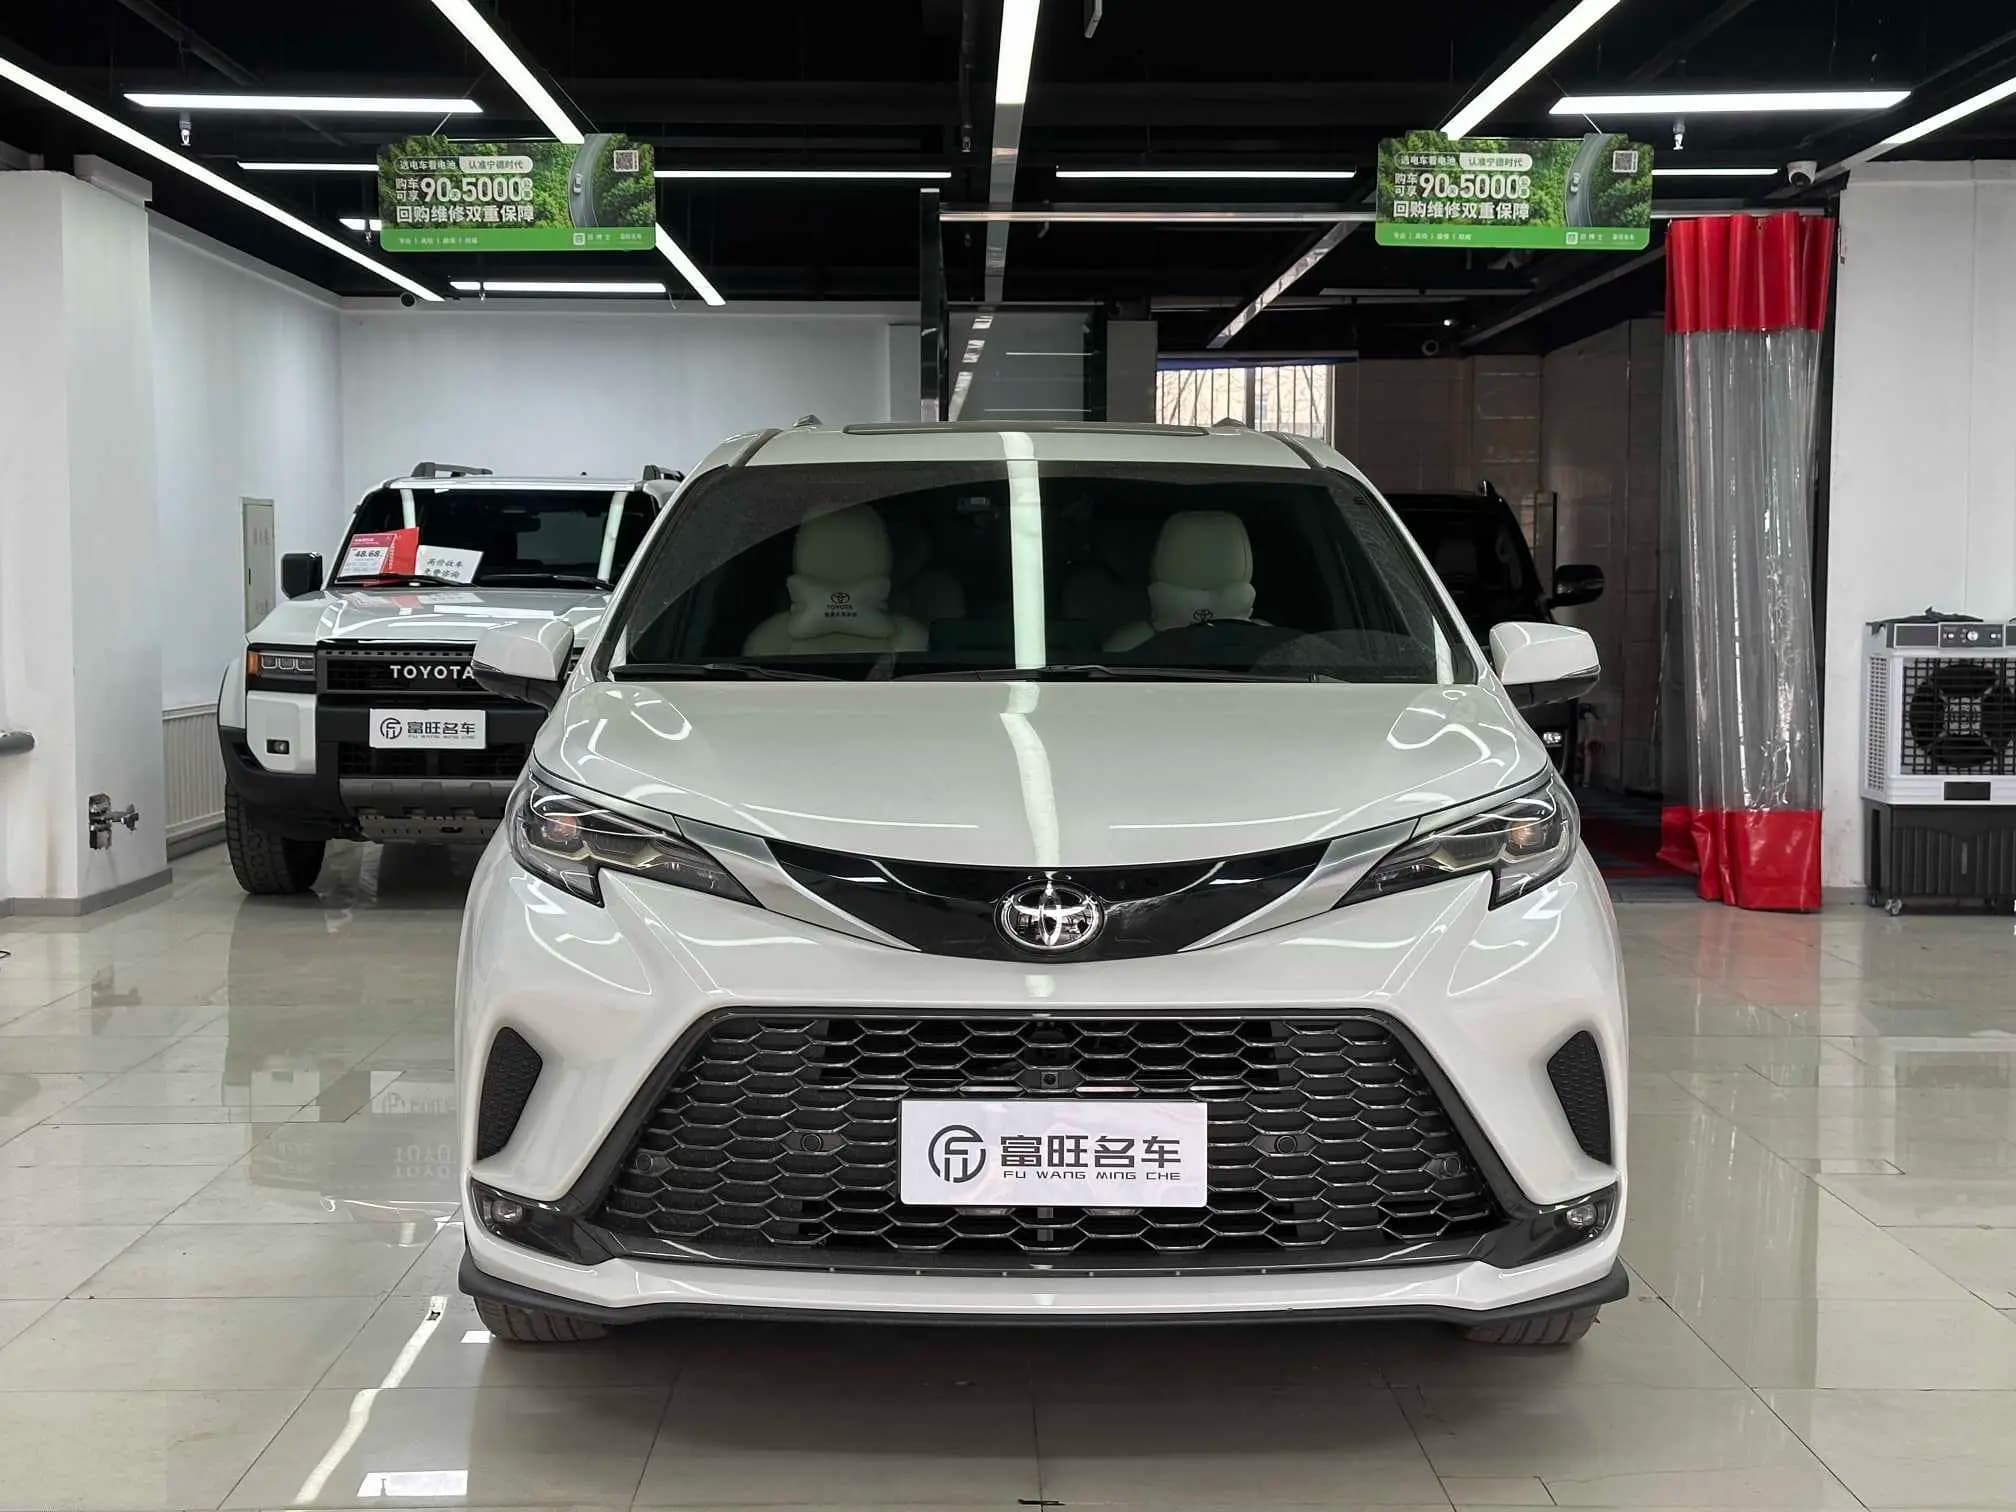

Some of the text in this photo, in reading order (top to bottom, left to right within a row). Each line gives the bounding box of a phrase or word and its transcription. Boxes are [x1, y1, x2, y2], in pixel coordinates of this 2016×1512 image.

[420, 177, 451, 202] 90
[461, 177, 522, 202] 5000
[1419, 172, 1450, 198] 90
[1460, 173, 1520, 199] 5000
[396, 205, 534, 223] 回购维修双重保障
[1393, 200, 1529, 220] 回购维修双重保障
[389, 665, 475, 679] TOYOTA
[407, 721, 475, 735] 富旺名车
[1000, 1134, 1182, 1169] 富旺名车
[1003, 1171, 1181, 1181] FU WANG MING CHE
